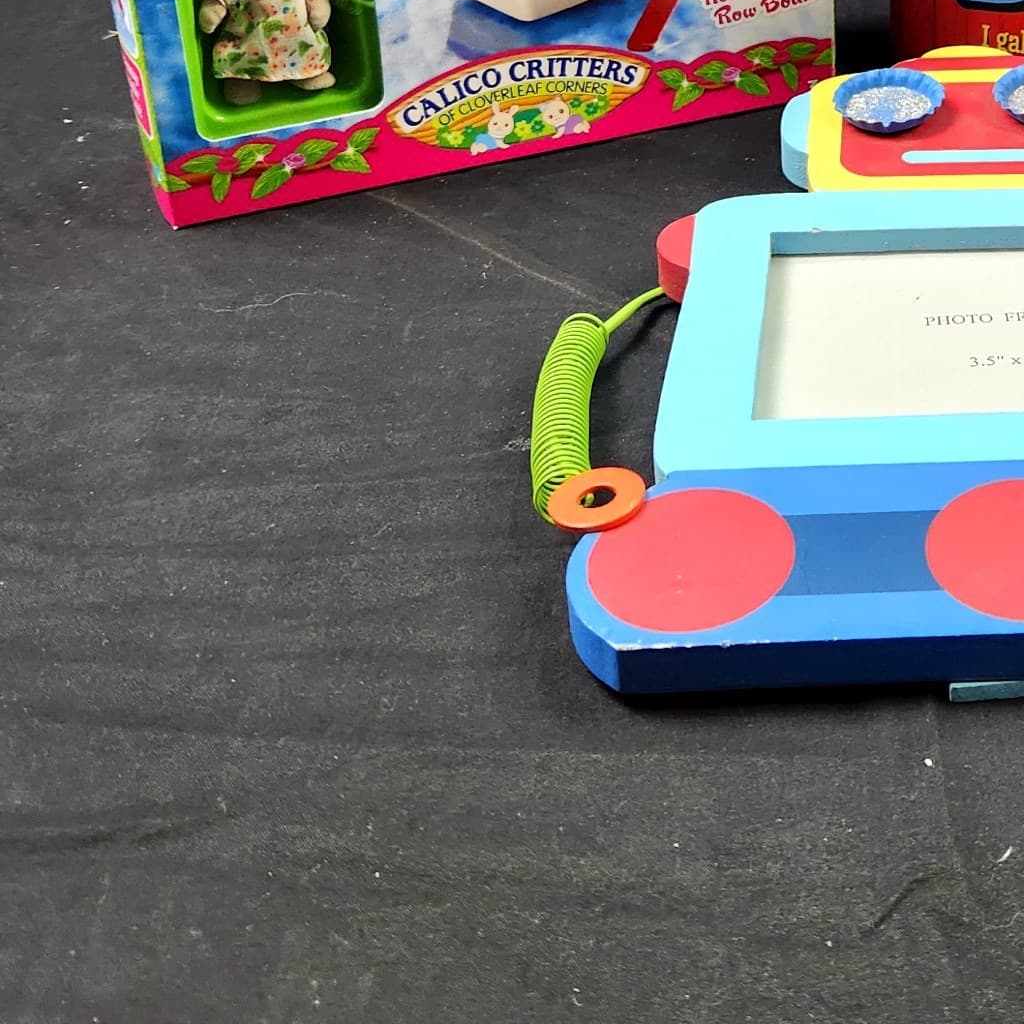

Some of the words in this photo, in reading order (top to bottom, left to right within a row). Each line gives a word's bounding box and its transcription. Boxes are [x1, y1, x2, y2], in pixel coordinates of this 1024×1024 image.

[714, 4, 757, 26] Row
[981, 24, 991, 47] I
[402, 68, 501, 127] CALICO
[508, 57, 639, 86] CRITTERS
[438, 110, 456, 127] OF
[457, 83, 543, 117] CLOVERLEAF
[546, 80, 608, 96] CORNERS
[925, 313, 993, 327] PHOTO
[969, 354, 1004, 368] 3.5"
[1010, 356, 1022, 365] x
